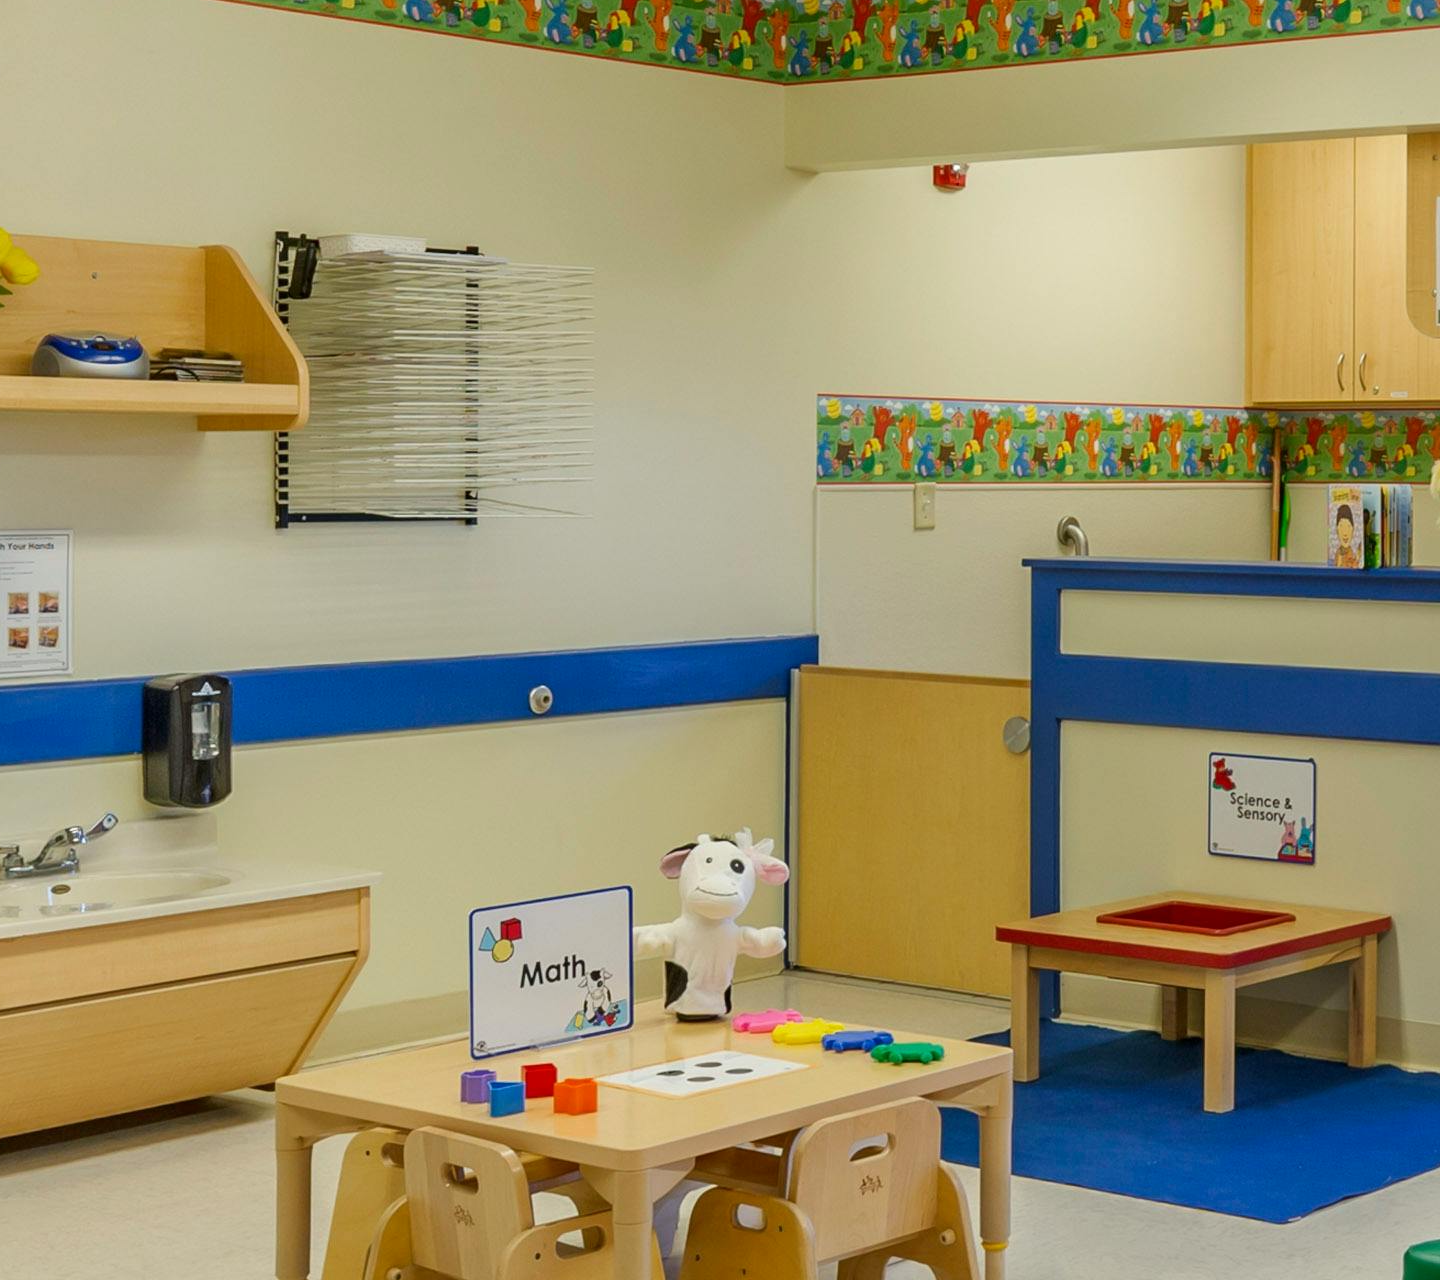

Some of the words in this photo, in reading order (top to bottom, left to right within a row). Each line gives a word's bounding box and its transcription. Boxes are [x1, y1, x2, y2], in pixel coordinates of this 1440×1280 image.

[7, 542, 26, 551] Your
[28, 542, 55, 551] Hands
[1230, 792, 1280, 808] Science
[1284, 798, 1293, 810] &
[1237, 806, 1285, 825] Sensory
[520, 954, 586, 988] Math
